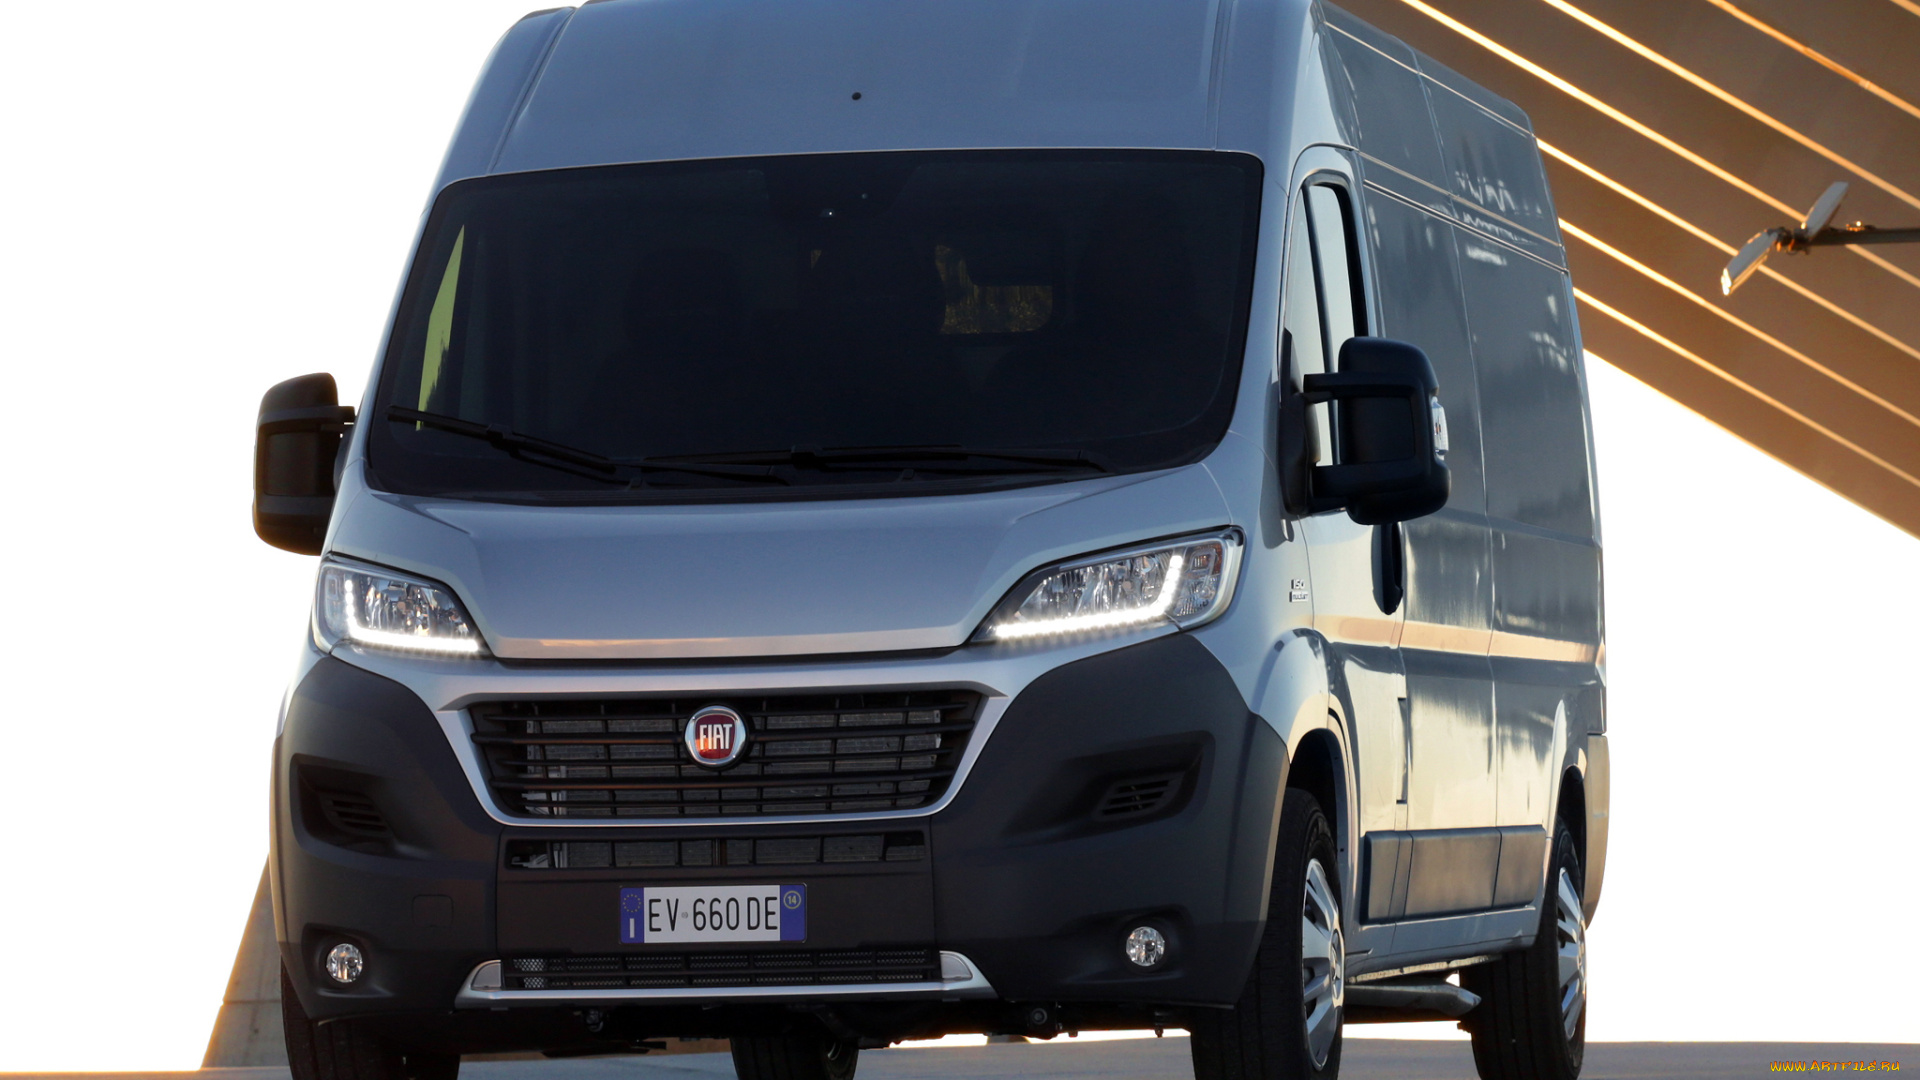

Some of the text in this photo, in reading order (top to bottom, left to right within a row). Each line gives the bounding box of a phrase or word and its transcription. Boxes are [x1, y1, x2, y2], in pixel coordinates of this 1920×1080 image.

[700, 724, 733, 750] FIAT
[787, 895, 798, 905] 14
[649, 896, 778, 931] EV 660 DE
